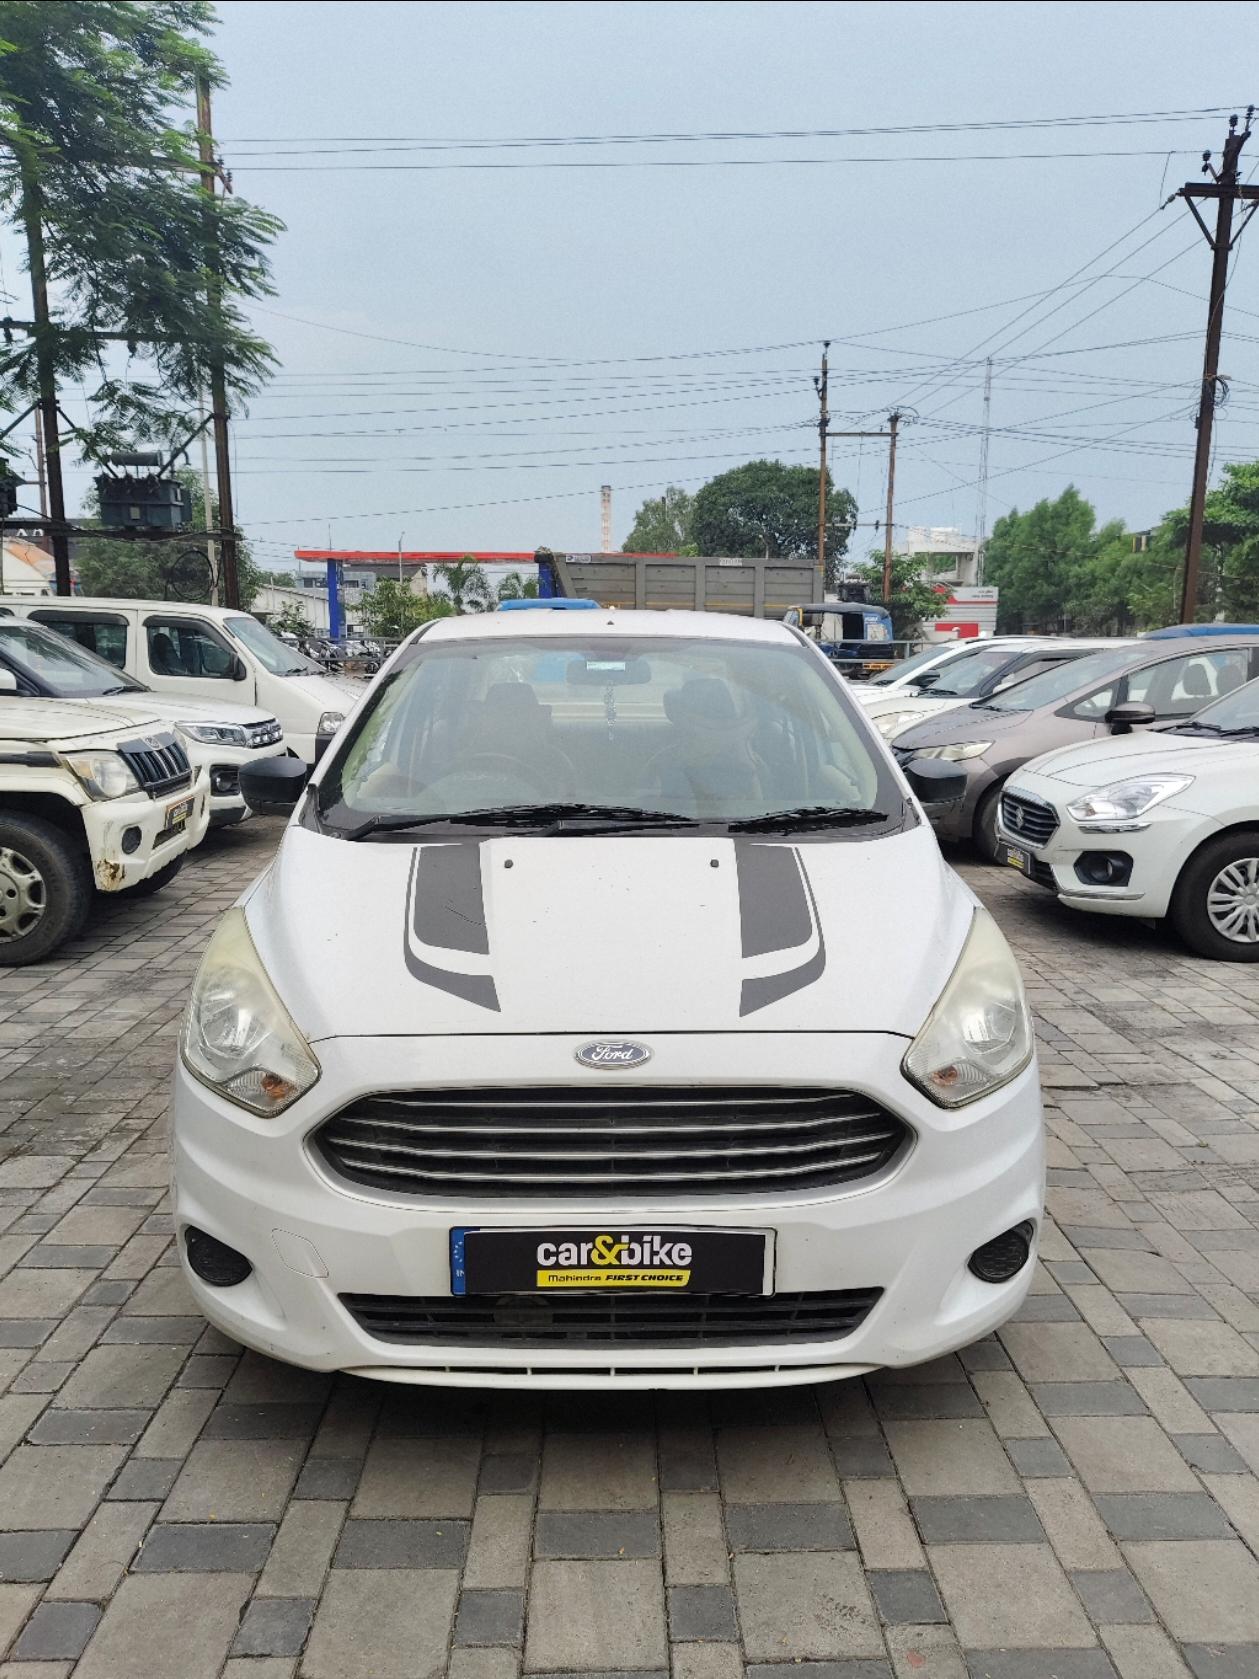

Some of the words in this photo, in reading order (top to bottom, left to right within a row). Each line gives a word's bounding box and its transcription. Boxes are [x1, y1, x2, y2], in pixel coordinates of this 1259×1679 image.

[591, 1045, 634, 1060] Ford
[536, 1235, 693, 1266] car&bike
[548, 1274, 601, 1282] Mahindra
